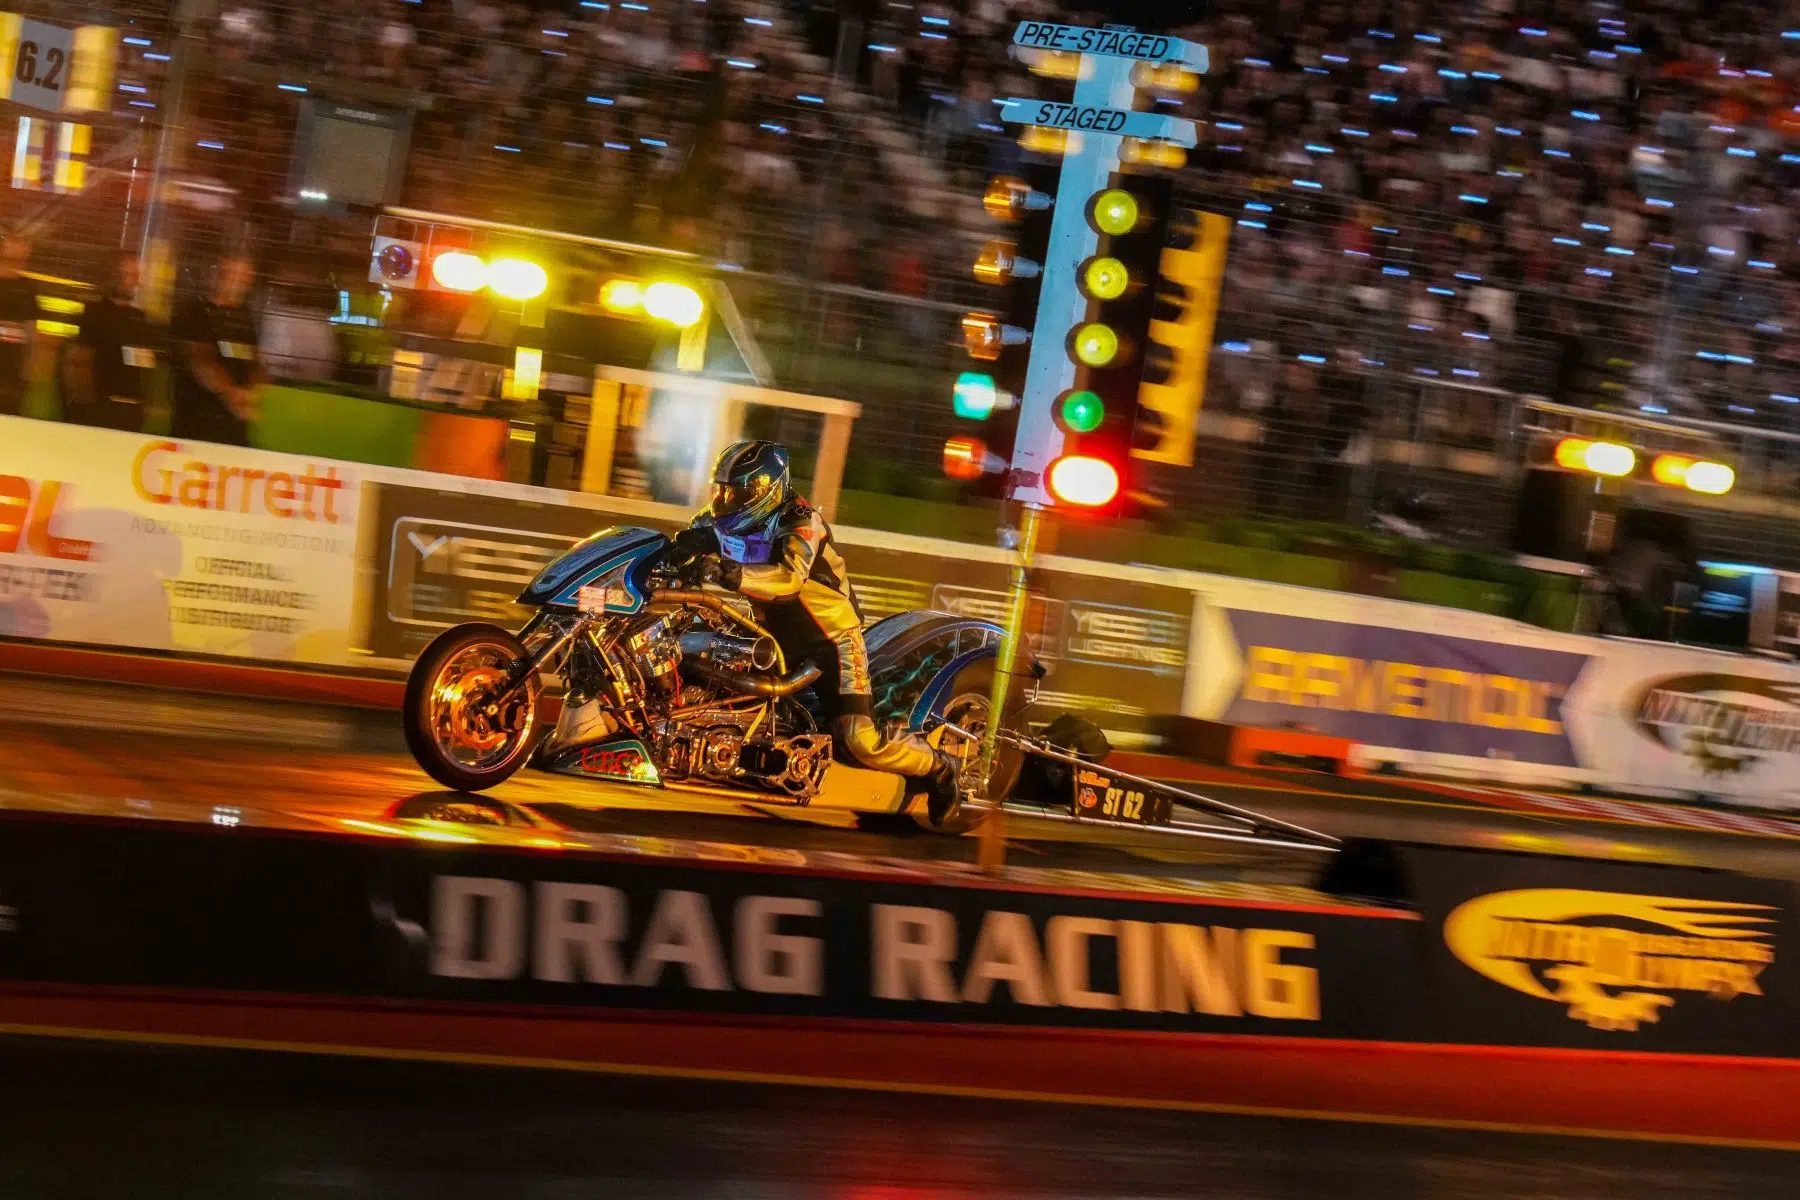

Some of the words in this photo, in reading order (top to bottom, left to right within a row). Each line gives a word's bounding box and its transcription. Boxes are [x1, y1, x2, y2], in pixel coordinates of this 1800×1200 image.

[1019, 23, 1169, 59] PRE-STAGED
[16, 40, 65, 92] 6.2
[1035, 103, 1127, 132] STAGED
[131, 439, 342, 524] Garrett
[163, 579, 307, 610] PERFORMANCE
[1102, 786, 1124, 817] ST
[428, 873, 825, 996] DRAG
[869, 902, 1321, 1021] RACING
